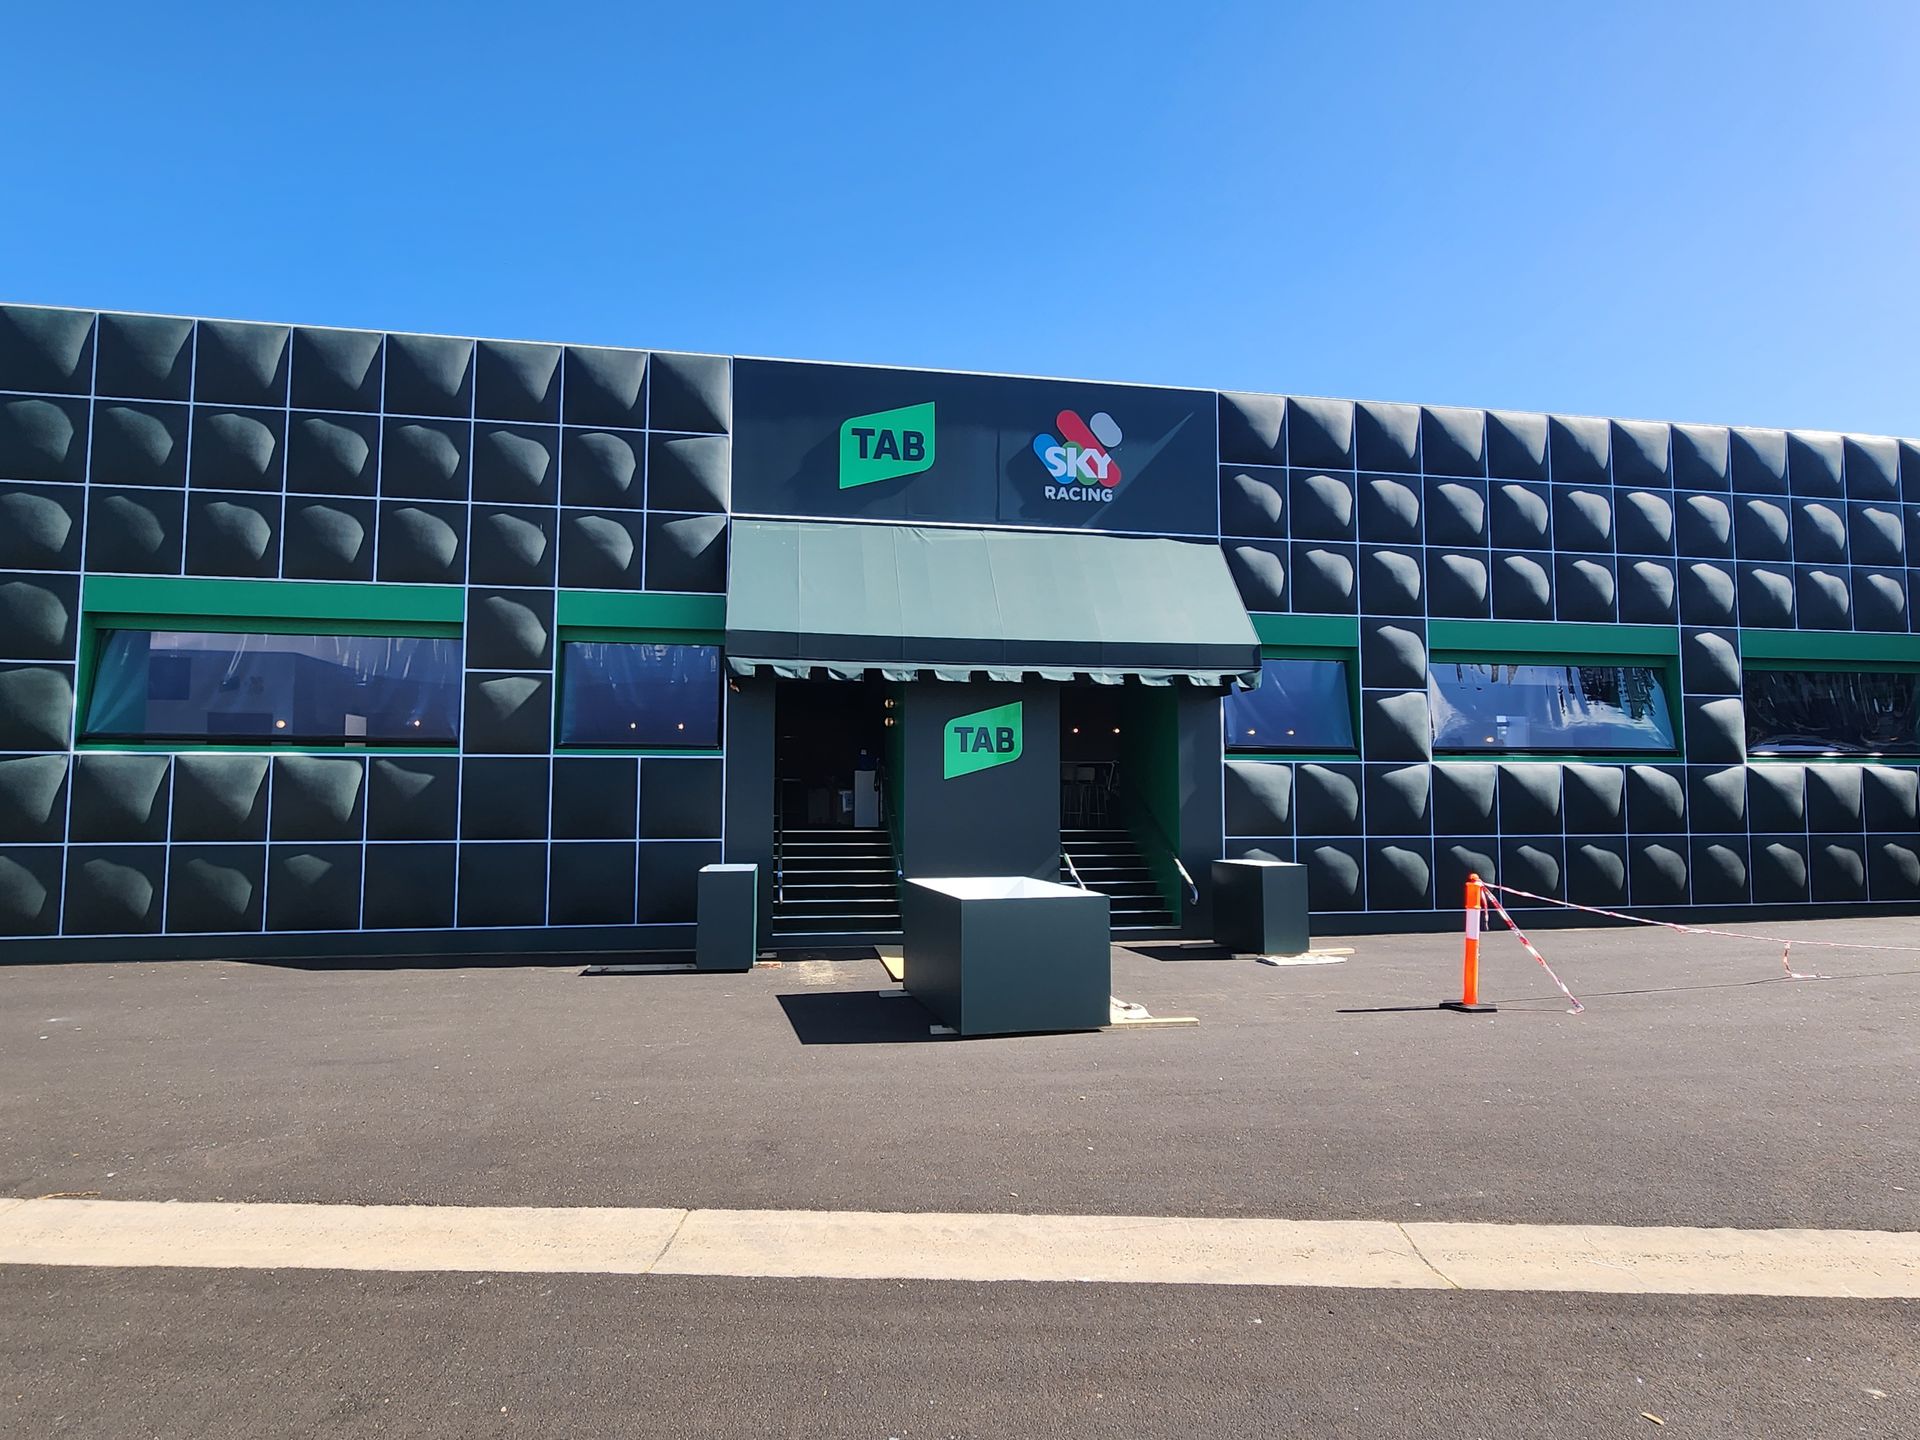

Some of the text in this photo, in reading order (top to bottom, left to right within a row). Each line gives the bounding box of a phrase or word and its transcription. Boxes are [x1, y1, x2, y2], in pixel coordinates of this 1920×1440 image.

[852, 428, 925, 461] TAB
[1045, 446, 1112, 479] SKY
[1044, 486, 1113, 502] RACING
[954, 727, 1015, 753] TAB
